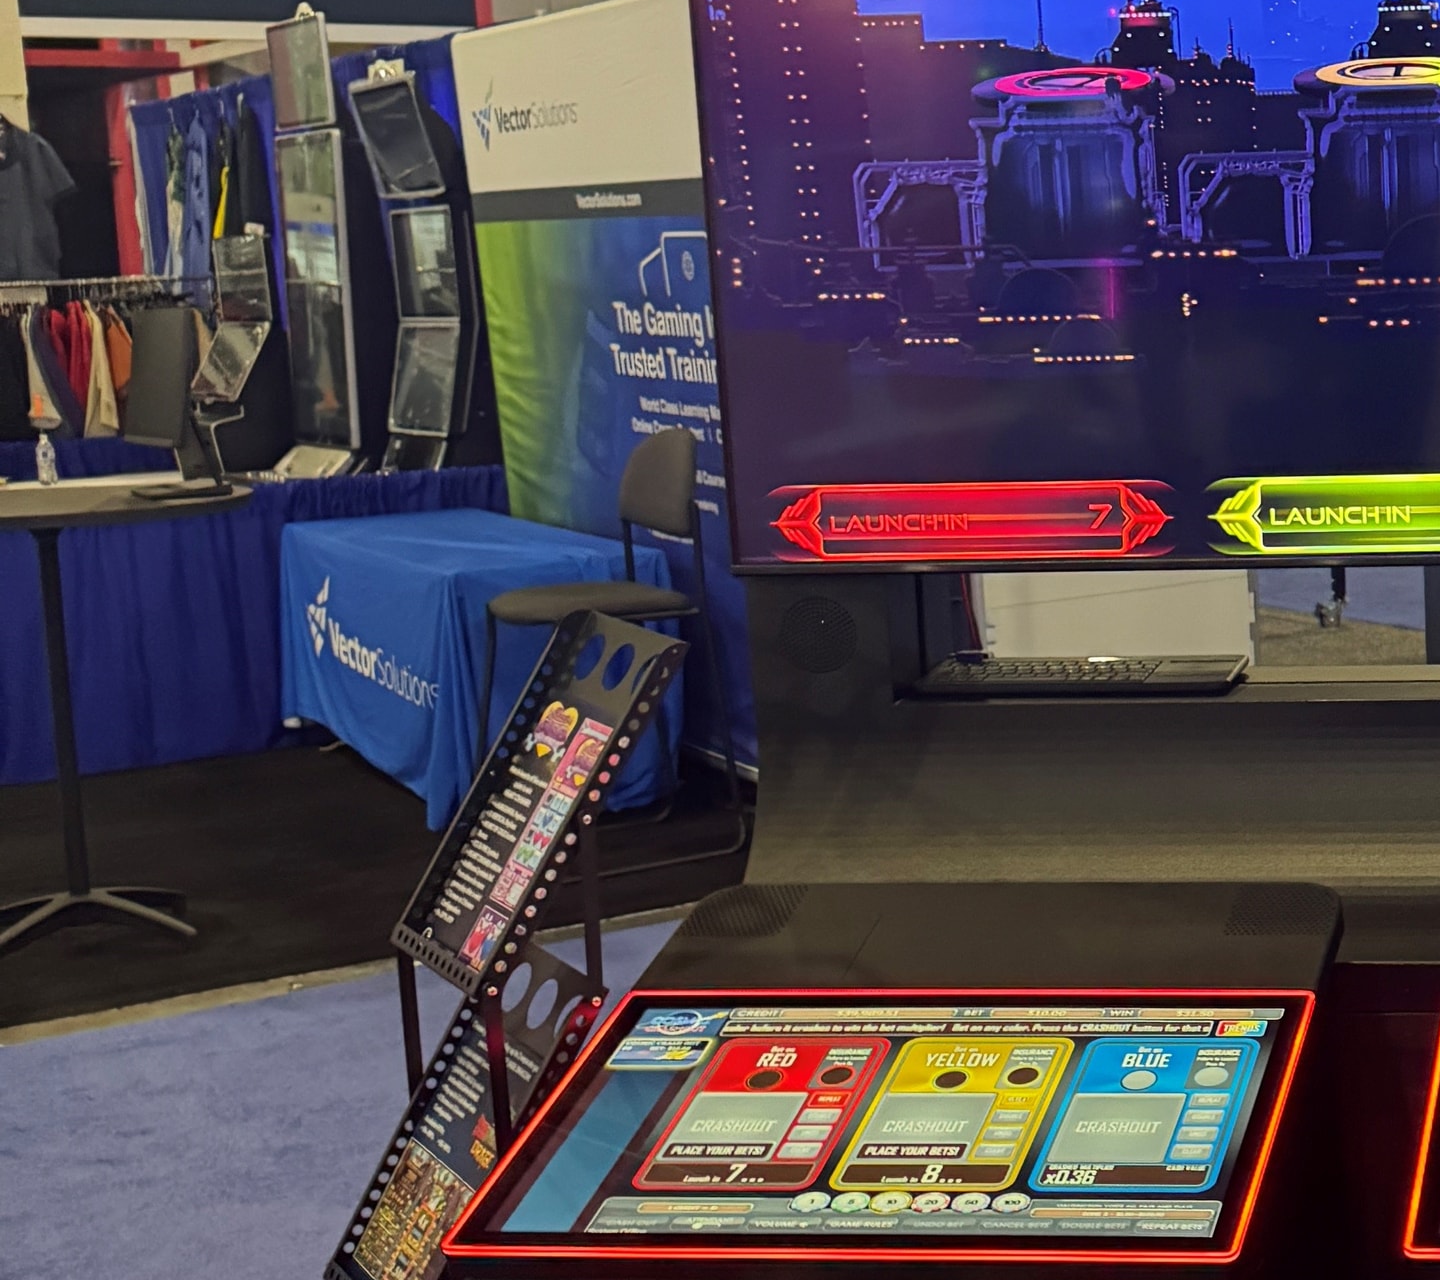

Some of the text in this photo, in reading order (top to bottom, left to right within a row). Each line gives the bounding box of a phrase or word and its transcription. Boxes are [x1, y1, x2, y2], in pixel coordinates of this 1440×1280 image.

[495, 102, 578, 133] VectorSolutions
[612, 301, 642, 335] The
[644, 302, 704, 347] Gaming
[610, 343, 666, 380] Trusted
[831, 514, 941, 532] LAUNCH
[1088, 503, 1113, 529] 7
[1270, 506, 1383, 526] LAUNCH
[1385, 505, 1411, 524] IN
[952, 1023, 968, 1032] Bet
[969, 1024, 982, 1032] on
[984, 1024, 1002, 1033] any
[1032, 1023, 1060, 1032] Press
[1062, 1023, 1078, 1032] the
[1080, 1023, 1131, 1032] CRASHOUT
[1132, 1023, 1162, 1032] button
[1164, 1023, 1180, 1032] for
[1182, 1023, 1202, 1032] that
[1223, 1024, 1261, 1033] TRENDS
[756, 1053, 798, 1067] RED
[925, 1053, 1000, 1067] YELLOW
[1121, 1054, 1172, 1068] BLUE
[691, 1120, 777, 1133] CRASHOUT
[882, 1121, 968, 1133] CRASHOUT
[1075, 1121, 1162, 1133] CRASHOUT
[671, 1146, 765, 1155] PLACE YOUR BETS!
[865, 1146, 959, 1156] PLACE YOUR BETS!
[1043, 1170, 1097, 1185] x0.36
